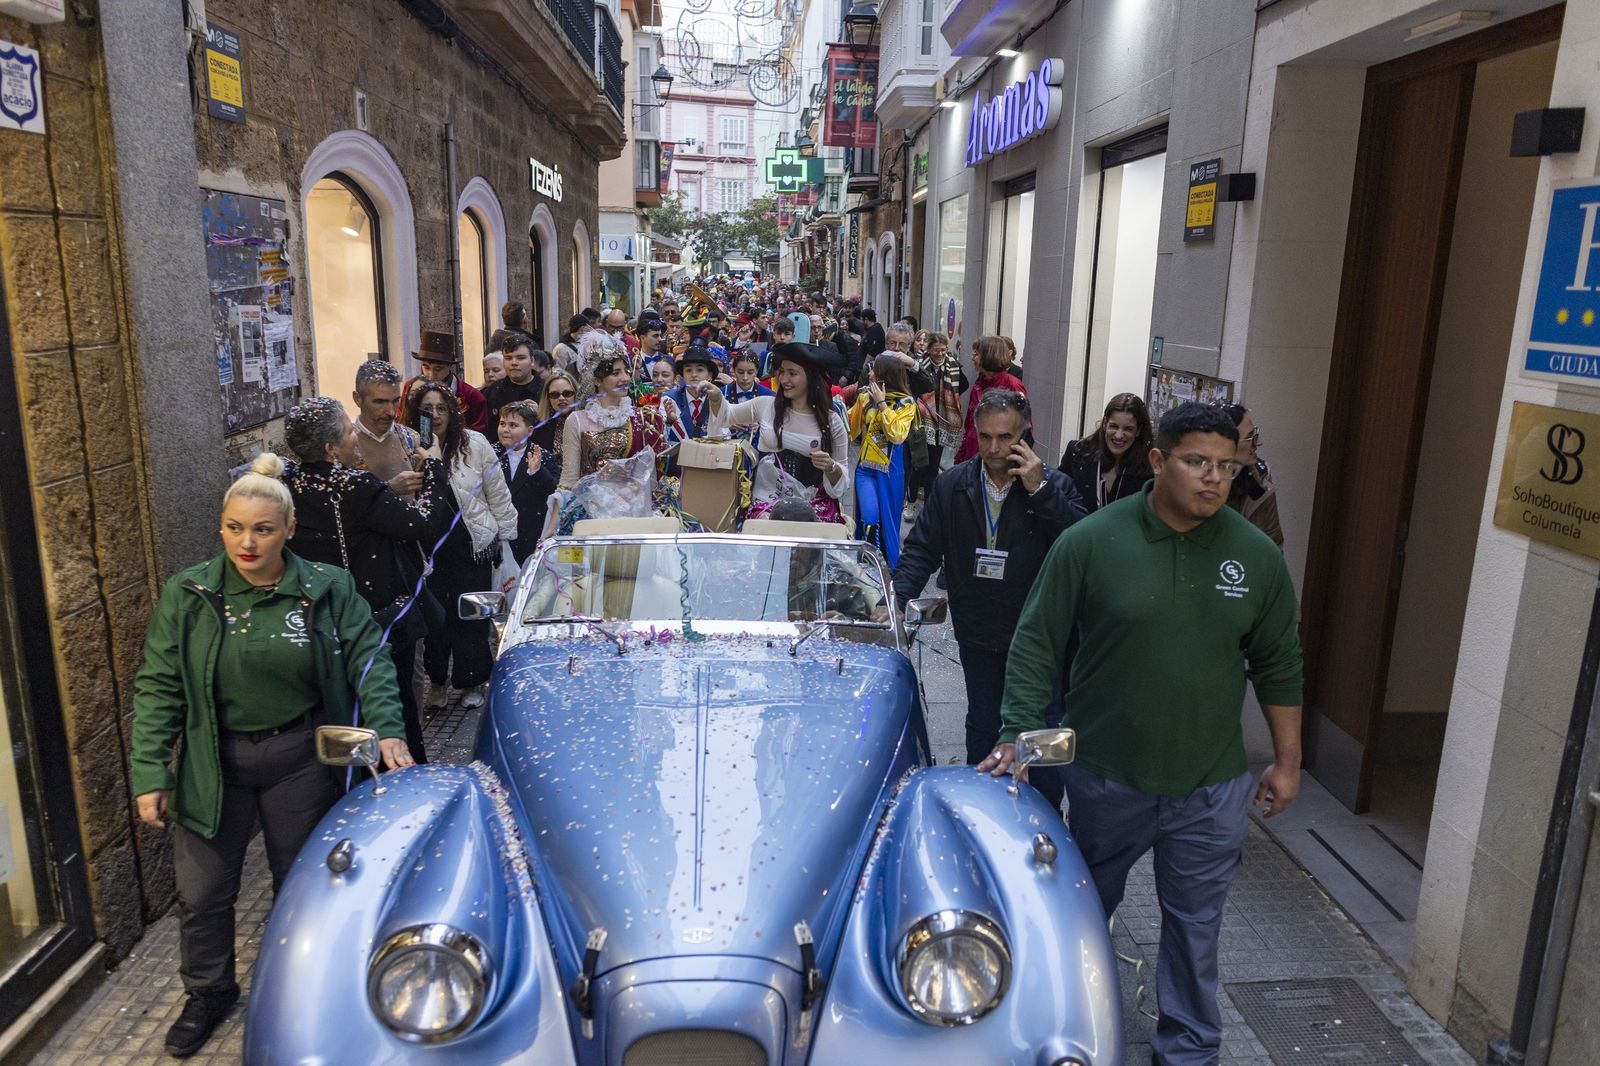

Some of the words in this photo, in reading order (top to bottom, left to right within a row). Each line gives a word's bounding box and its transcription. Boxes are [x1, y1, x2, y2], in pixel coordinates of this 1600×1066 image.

[209, 57, 240, 75] CONECTADA
[846, 78, 876, 94] latido
[832, 92, 845, 105] de
[846, 93, 874, 107] Cádiz
[964, 57, 1053, 168] Aromas
[1191, 190, 1214, 199] CONECTADA
[850, 212, 858, 276] FARMACIA
[1512, 485, 1600, 526] SohoBoutique
[1522, 509, 1582, 540] Columela
